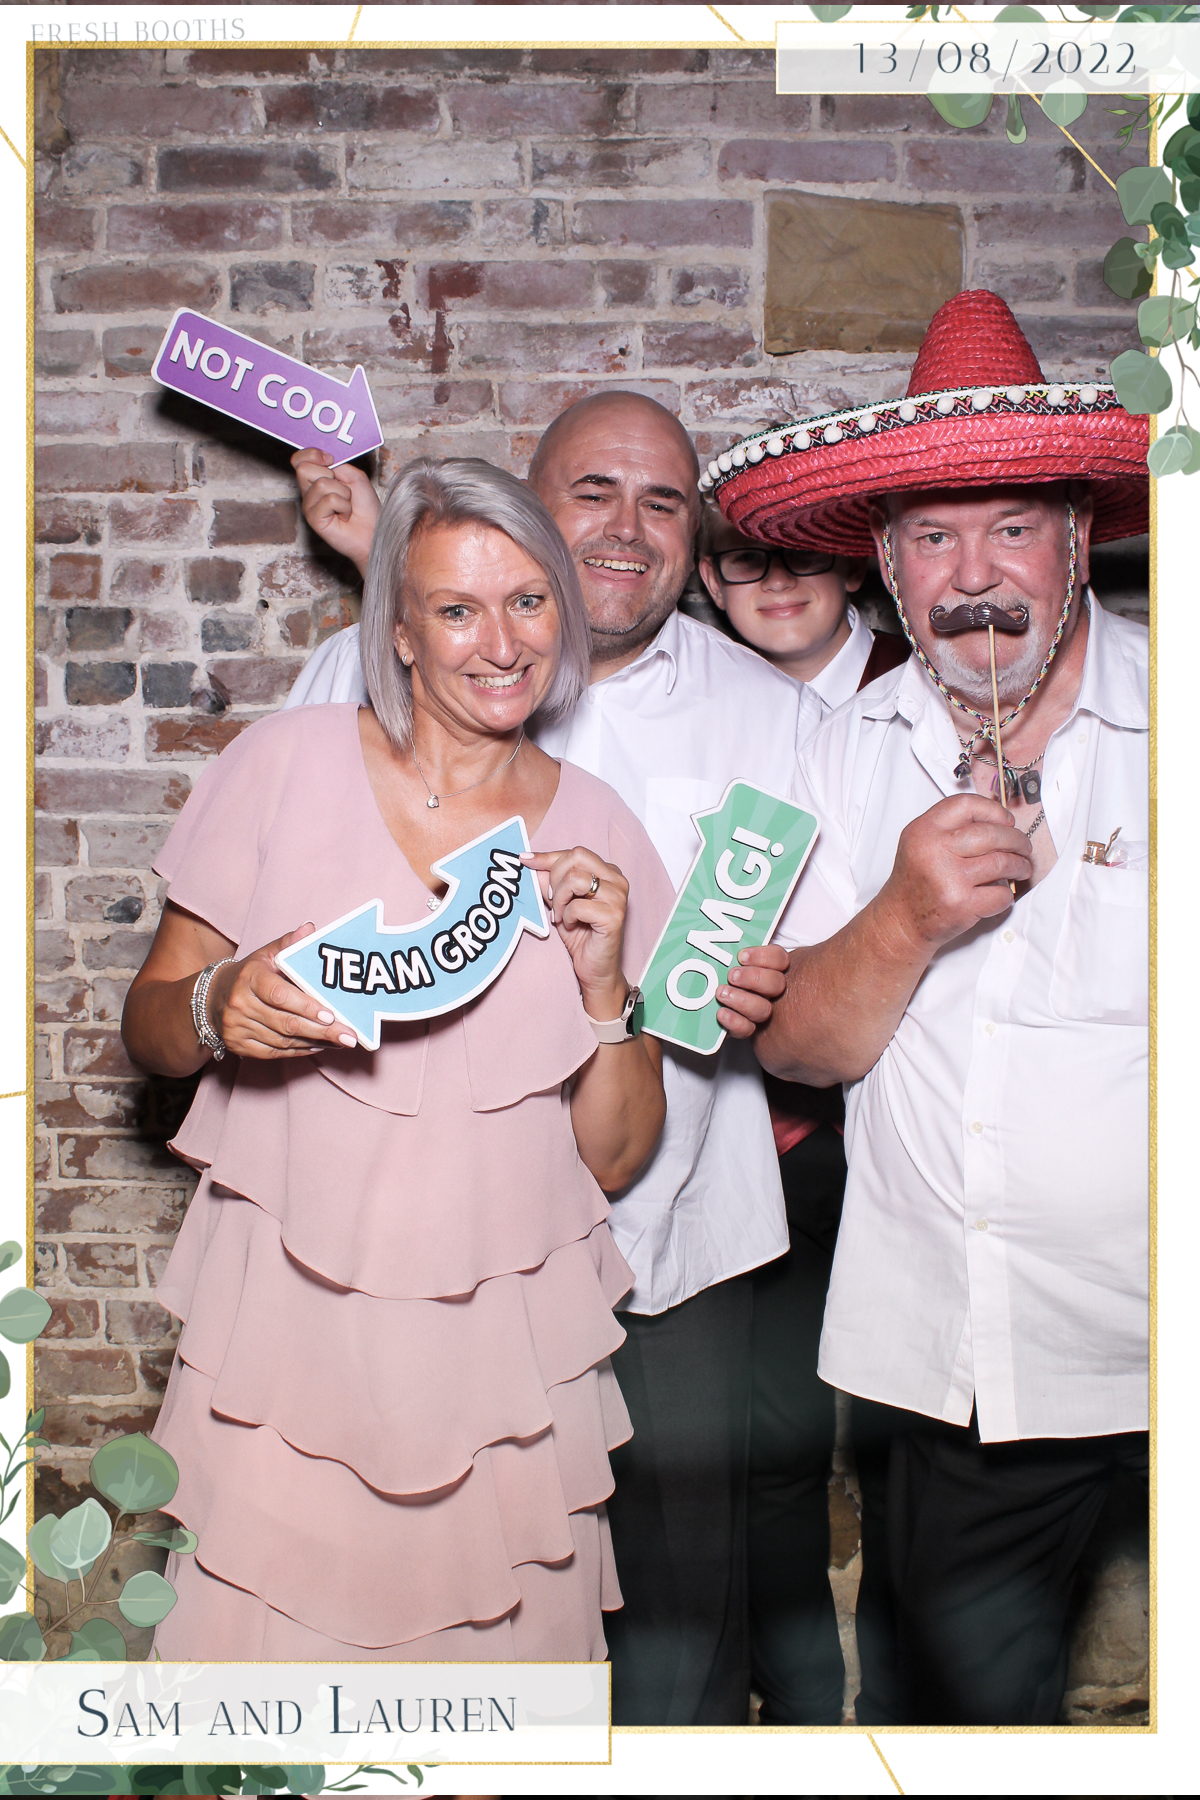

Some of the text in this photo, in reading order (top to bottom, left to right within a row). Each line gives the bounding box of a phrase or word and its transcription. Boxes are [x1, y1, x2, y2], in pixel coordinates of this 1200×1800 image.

[170, 329, 356, 445] NOT COOL
[319, 849, 523, 993] TEAM GROOM
[665, 826, 784, 1011] OMG!
